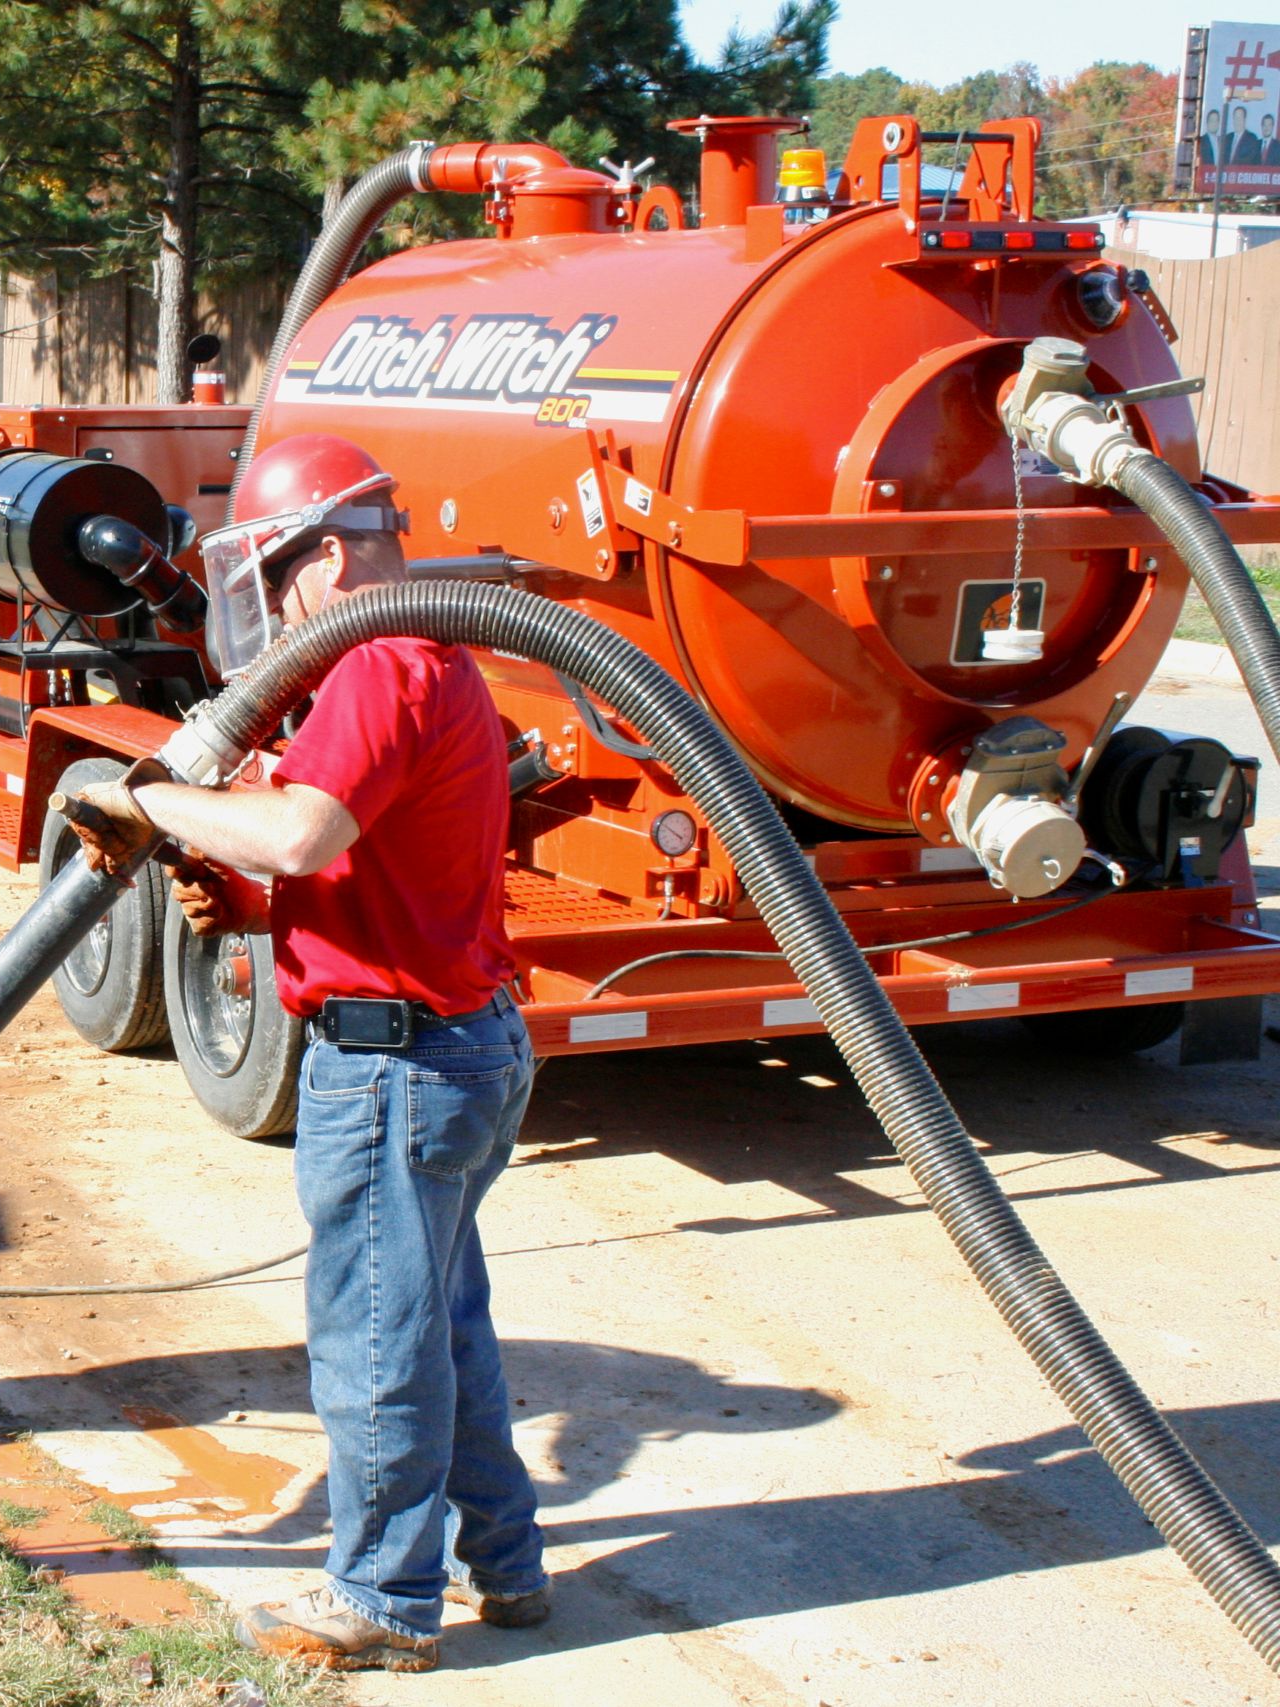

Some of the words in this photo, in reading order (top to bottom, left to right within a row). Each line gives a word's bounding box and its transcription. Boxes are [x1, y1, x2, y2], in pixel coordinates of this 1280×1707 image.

[313, 322, 446, 388] Ditch
[433, 322, 592, 394] Witch
[537, 398, 589, 422] 800
